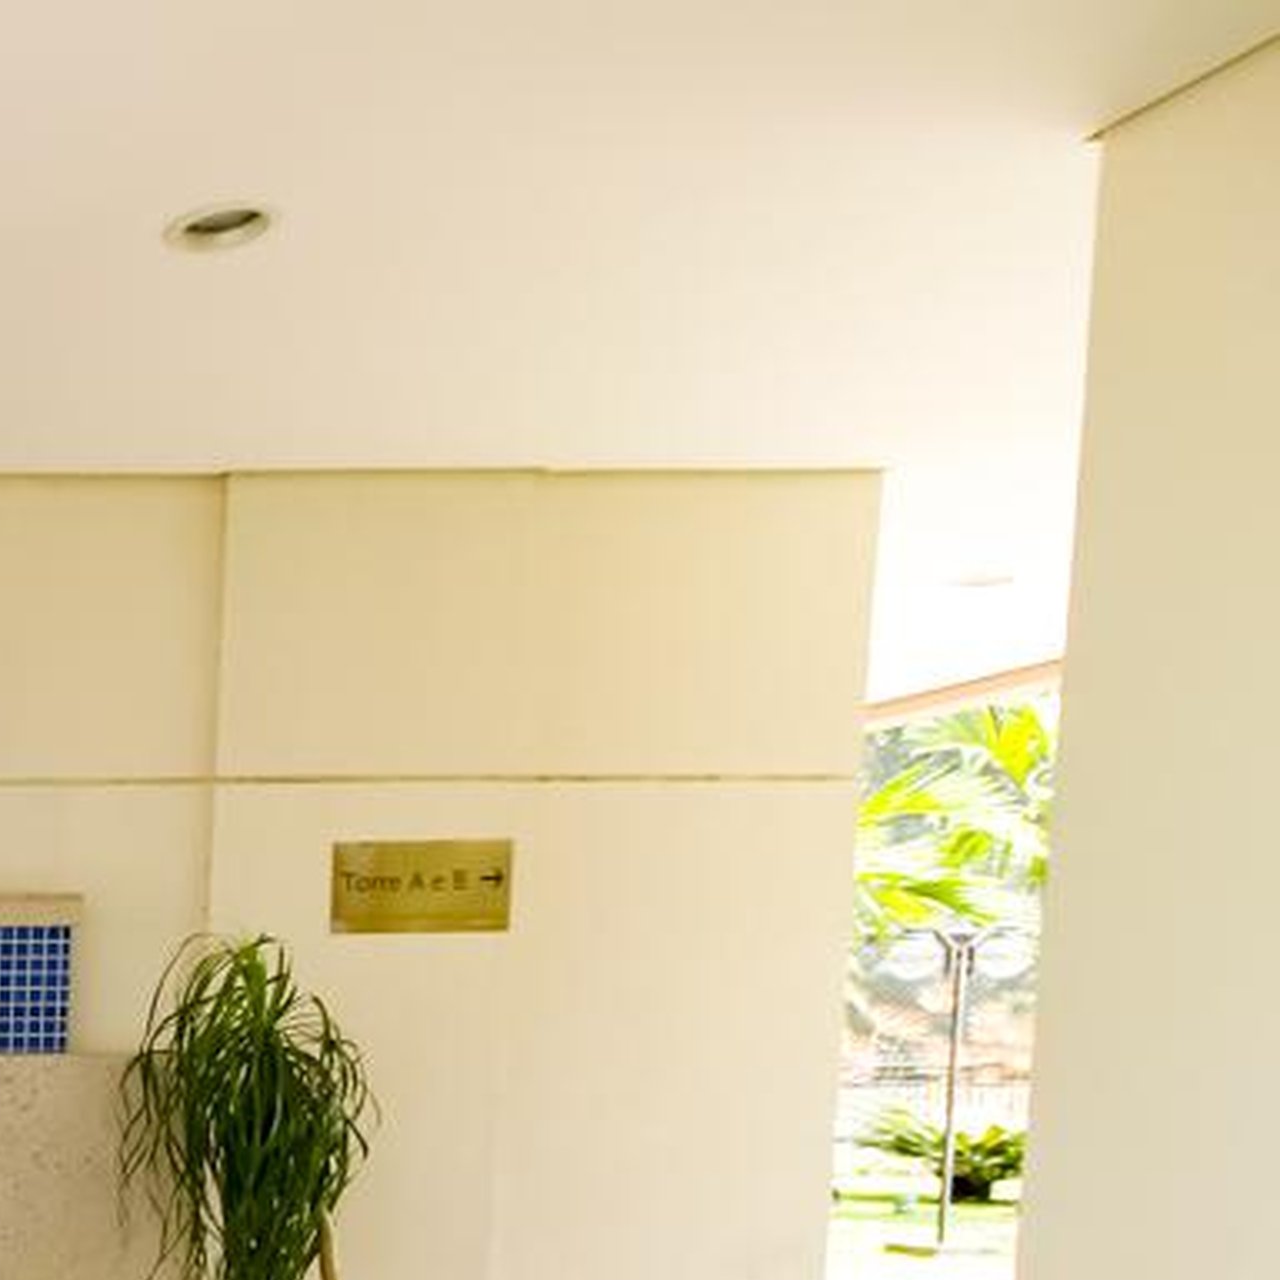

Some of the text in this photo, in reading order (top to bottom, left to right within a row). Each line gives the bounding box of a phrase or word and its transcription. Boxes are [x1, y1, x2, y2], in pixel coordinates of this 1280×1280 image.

[339, 870, 402, 892] Torre
[407, 871, 426, 892] A
[431, 874, 448, 892] e
